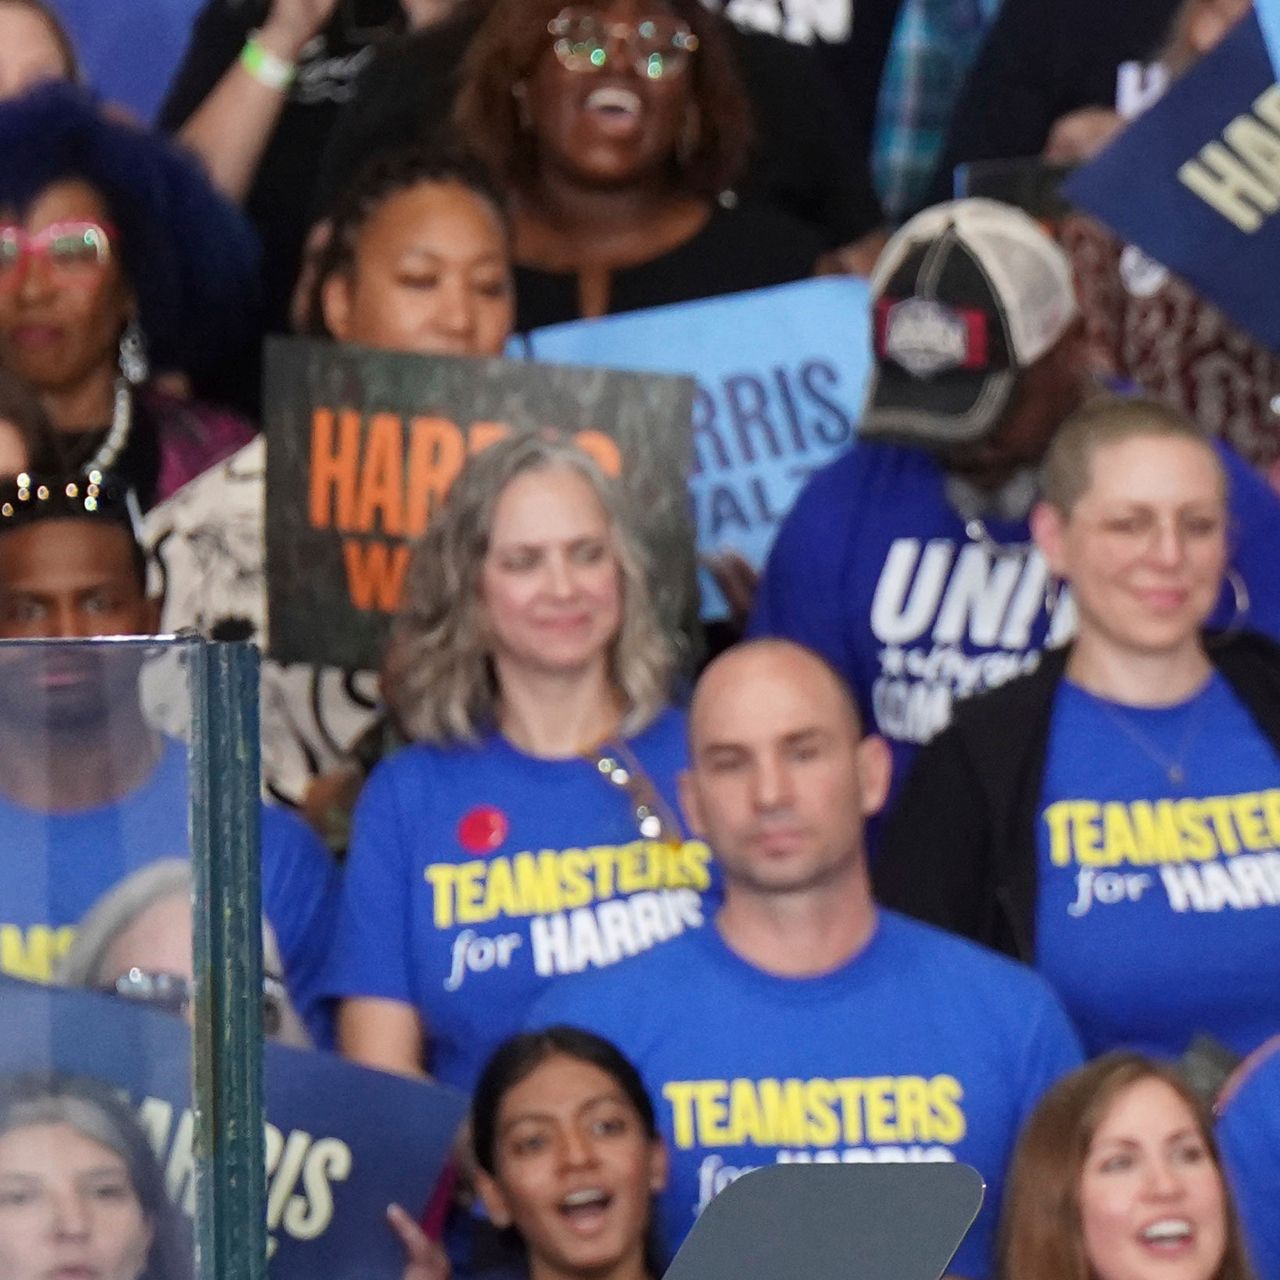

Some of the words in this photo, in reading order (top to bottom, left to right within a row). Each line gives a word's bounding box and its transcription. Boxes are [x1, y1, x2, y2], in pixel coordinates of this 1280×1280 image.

[424, 839, 712, 930] TEAMSTERS
[1068, 865, 1151, 917] for
[442, 929, 522, 992] for
[662, 1074, 967, 1150] TEAMSTERS
